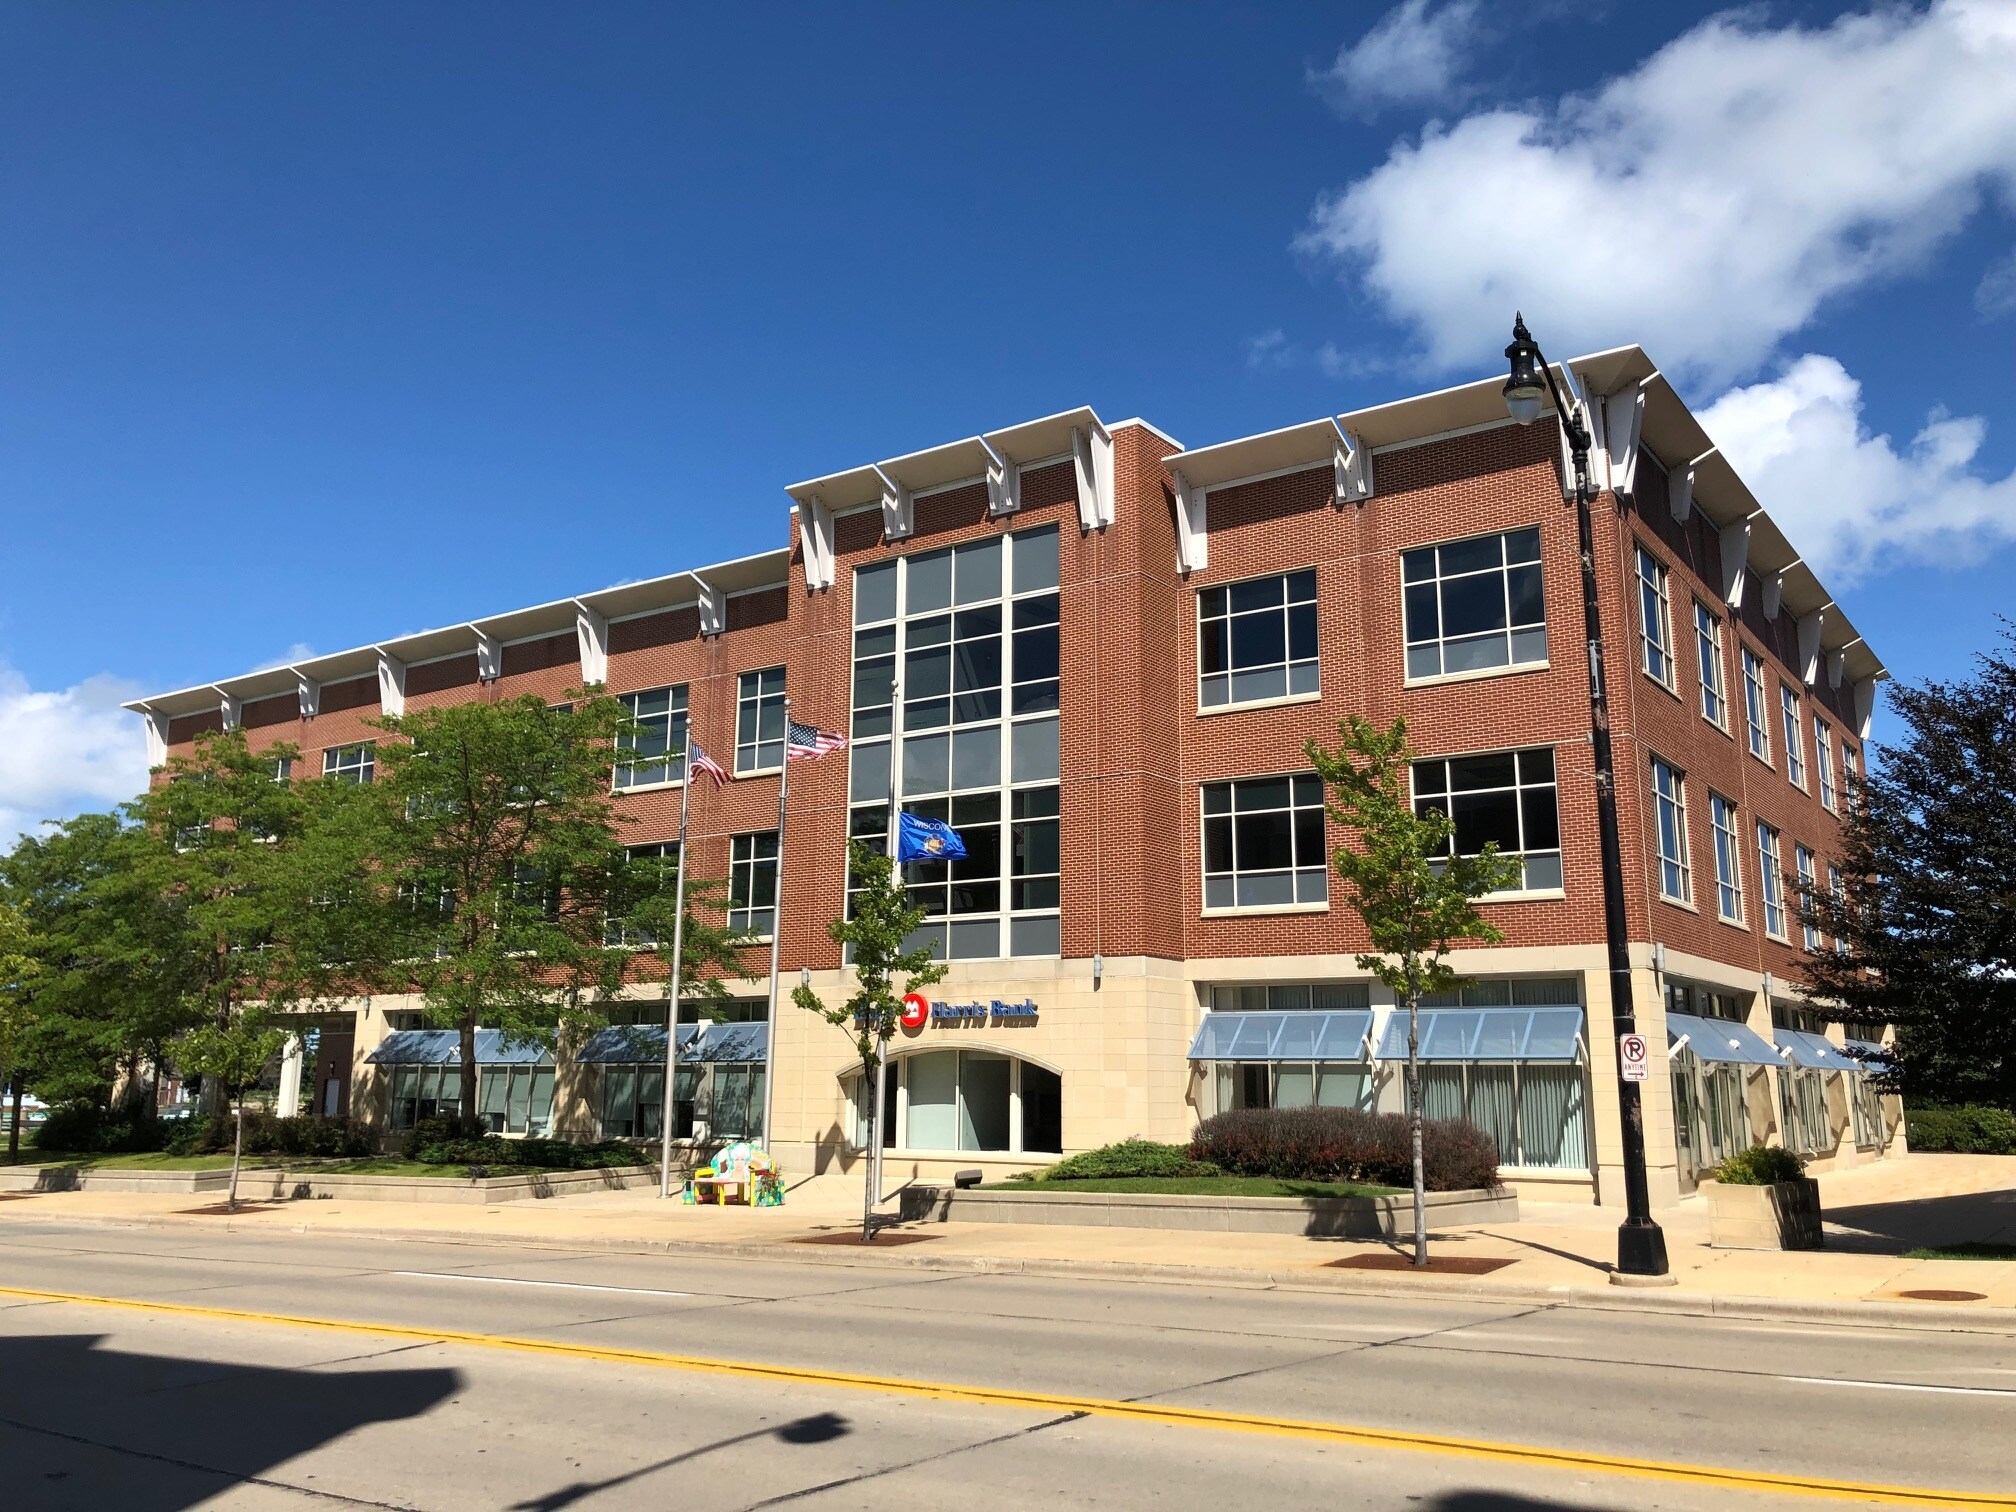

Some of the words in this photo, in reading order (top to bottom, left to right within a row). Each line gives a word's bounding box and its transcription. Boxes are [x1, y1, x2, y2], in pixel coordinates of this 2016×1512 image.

[930, 1000, 987, 1018] Harris
[990, 998, 1038, 1016] Bank
[1624, 1063, 1646, 1071] ANYTIME
